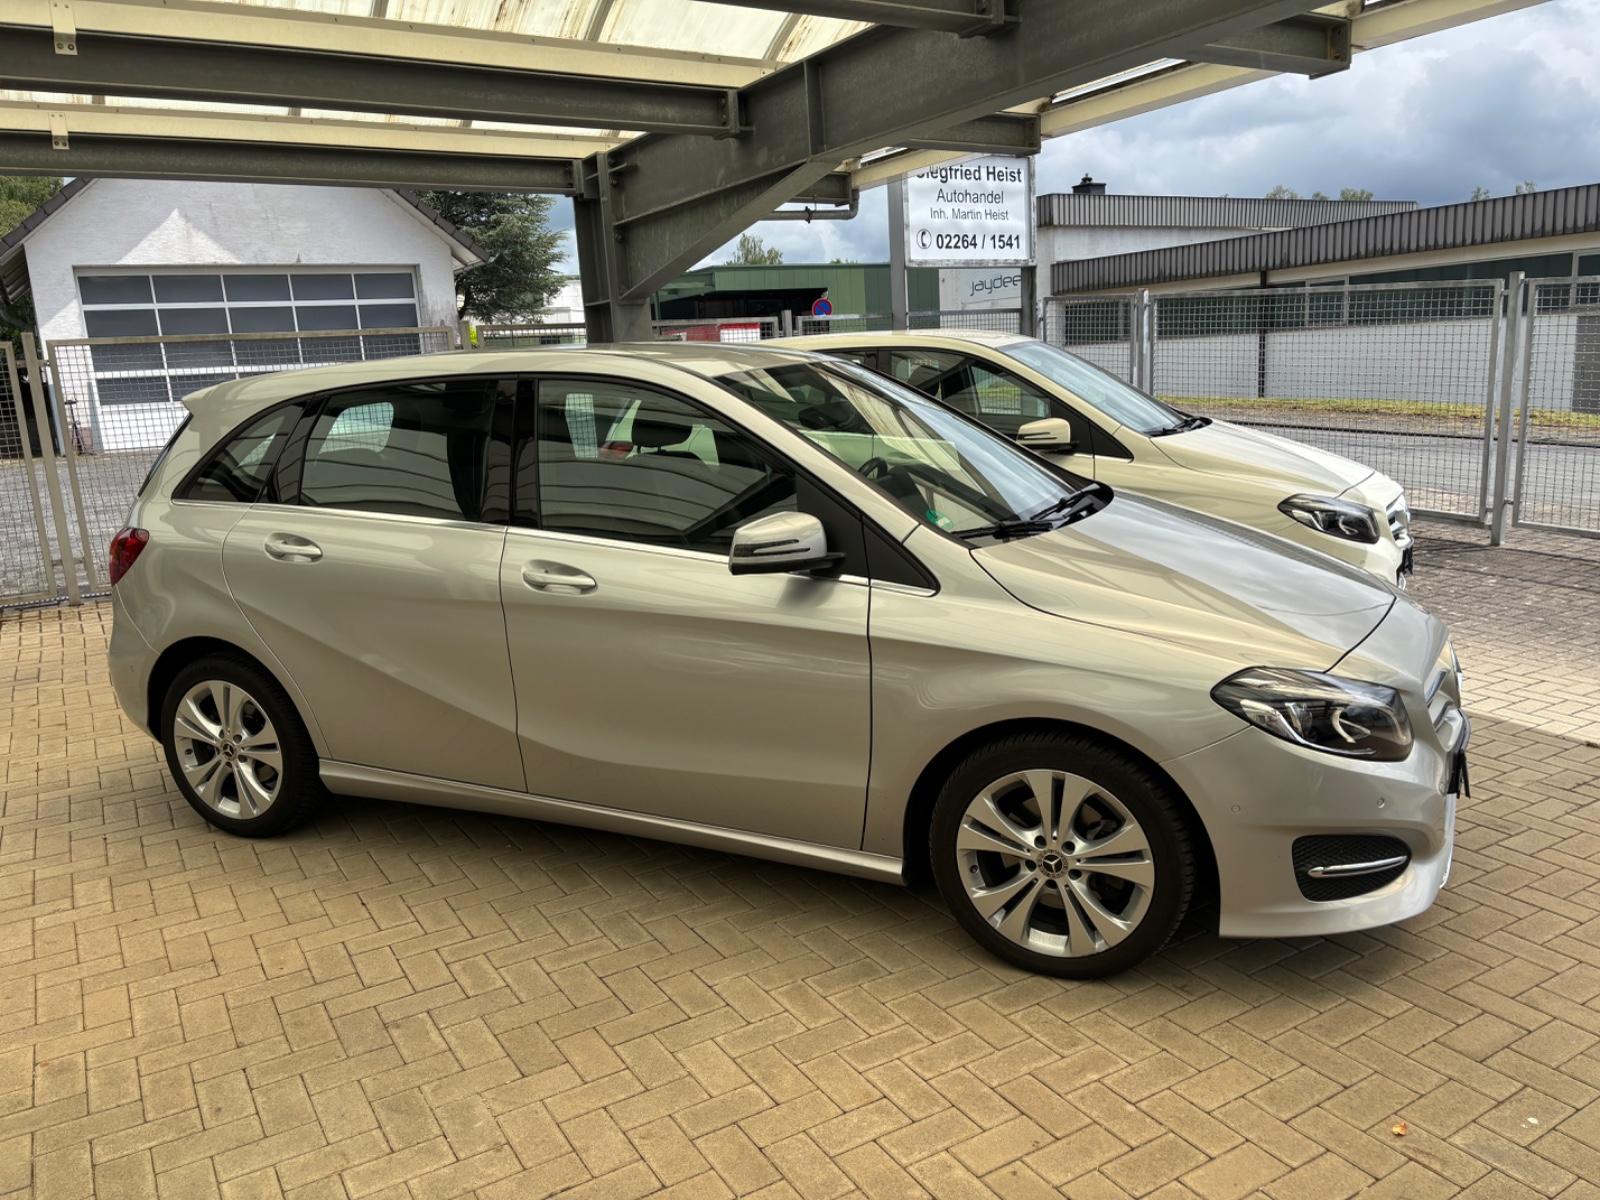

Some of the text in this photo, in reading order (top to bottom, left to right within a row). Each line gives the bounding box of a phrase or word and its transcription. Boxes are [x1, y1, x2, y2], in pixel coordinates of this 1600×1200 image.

[986, 165, 1022, 182] Heist
[936, 188, 1004, 204] Autohandel
[930, 207, 1009, 220] Inh. Martin Heist
[936, 233, 1020, 249] 02264 / 1541
[969, 274, 1022, 296] jaydee
